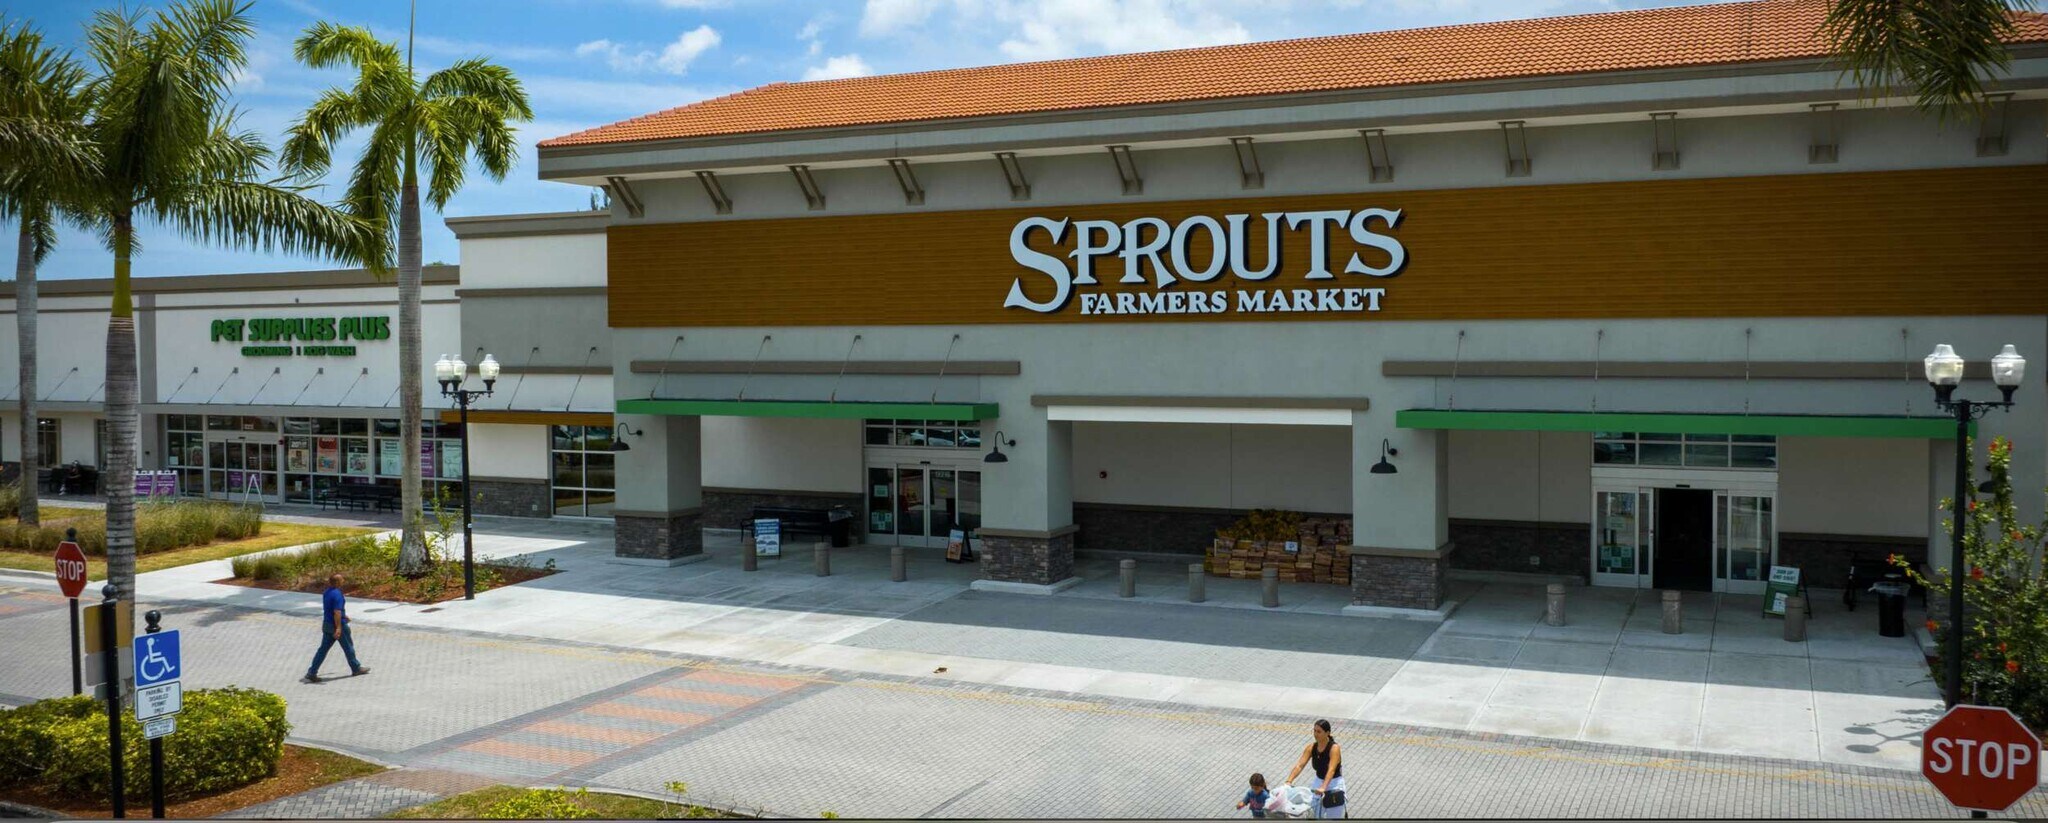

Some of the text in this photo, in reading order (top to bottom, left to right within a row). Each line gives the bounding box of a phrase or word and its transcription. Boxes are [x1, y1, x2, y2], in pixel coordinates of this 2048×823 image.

[1003, 208, 1406, 313] SPROUTS
[1080, 288, 1386, 315] FARMERS MARKET
[211, 316, 390, 342] PET SUPPLIES PLUS
[57, 559, 84, 581] STOP
[1929, 737, 2032, 780] STOP
